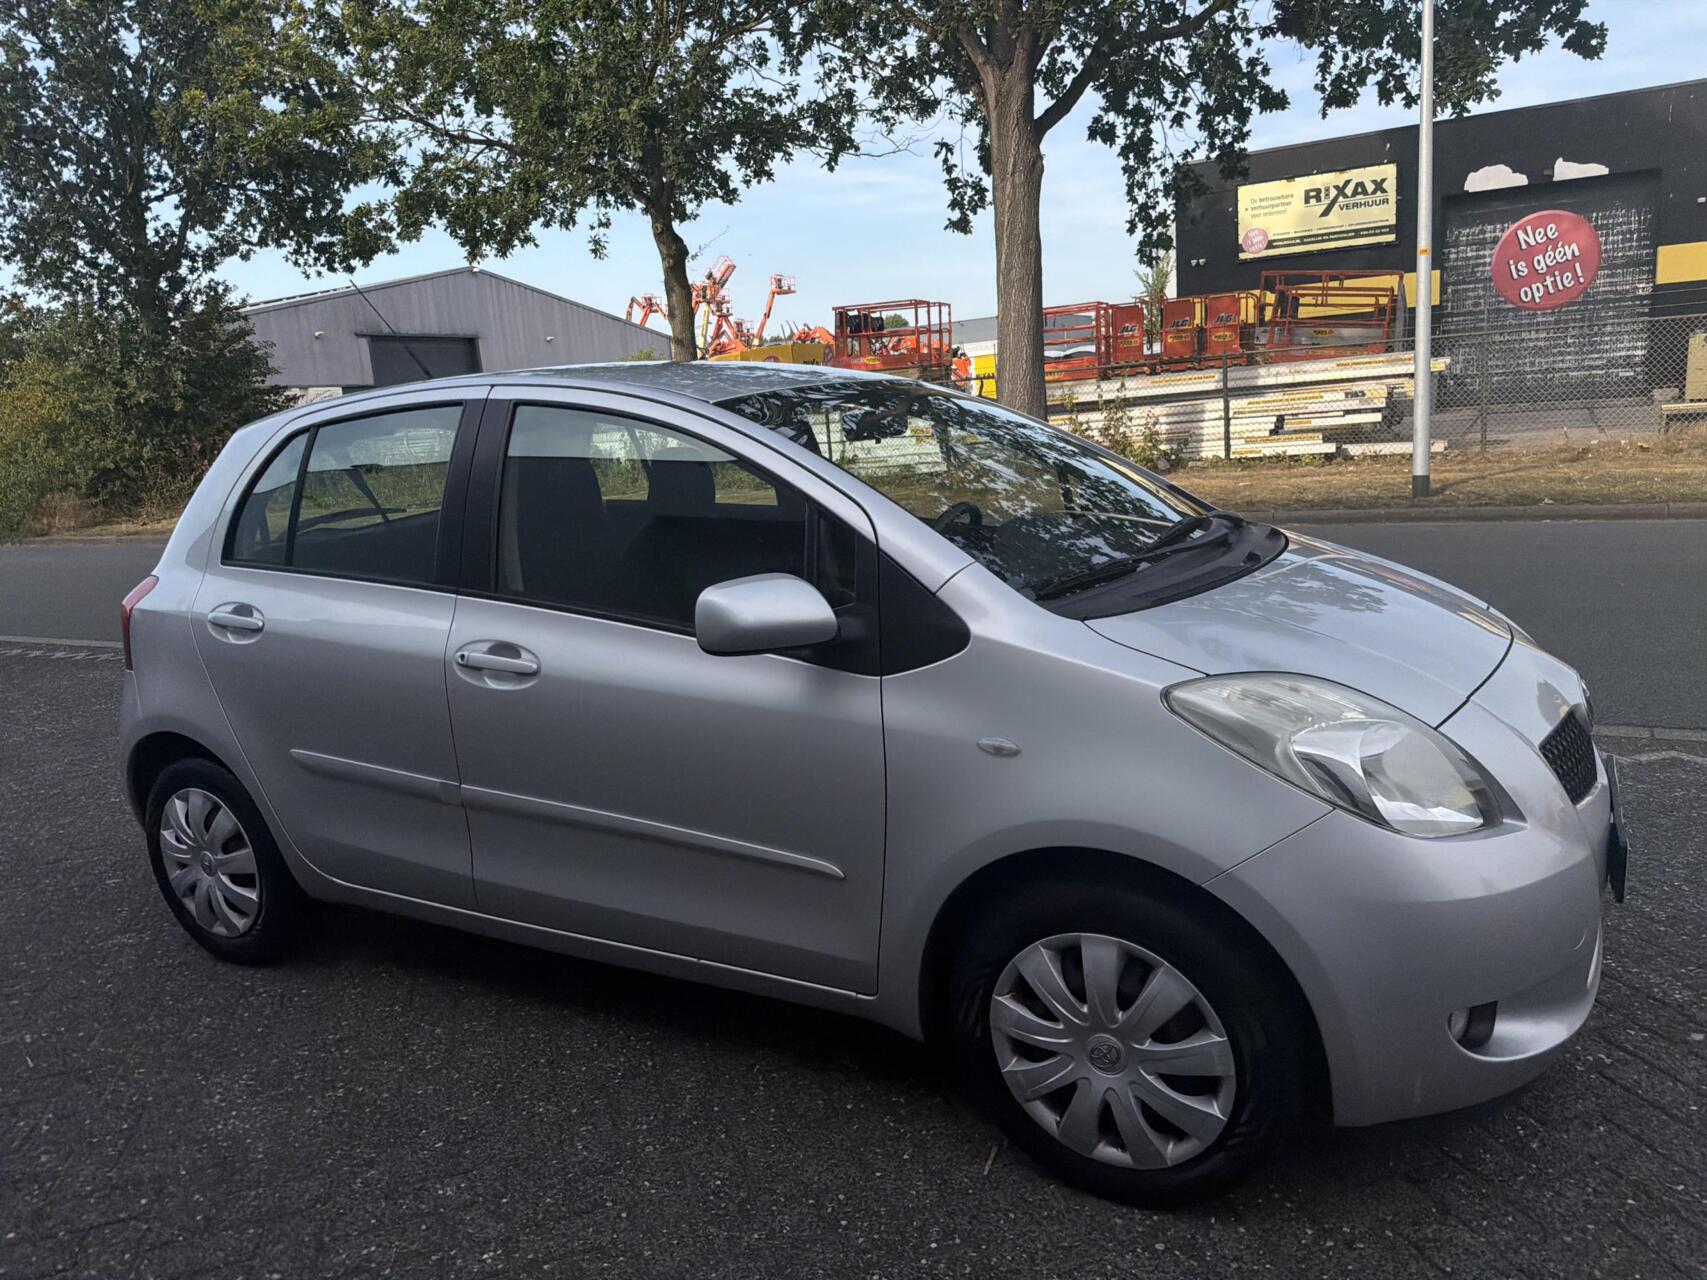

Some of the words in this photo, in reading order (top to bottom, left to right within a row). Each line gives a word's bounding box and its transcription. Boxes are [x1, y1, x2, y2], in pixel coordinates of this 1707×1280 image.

[1338, 197, 1389, 211] VERHUUR
[1517, 223, 1559, 250] Nee
[1509, 259, 1529, 280] is
[1533, 241, 1580, 274] géén
[1169, 319, 1189, 328] JLG
[1214, 314, 1234, 323] JLG
[1119, 324, 1138, 334] JLG
